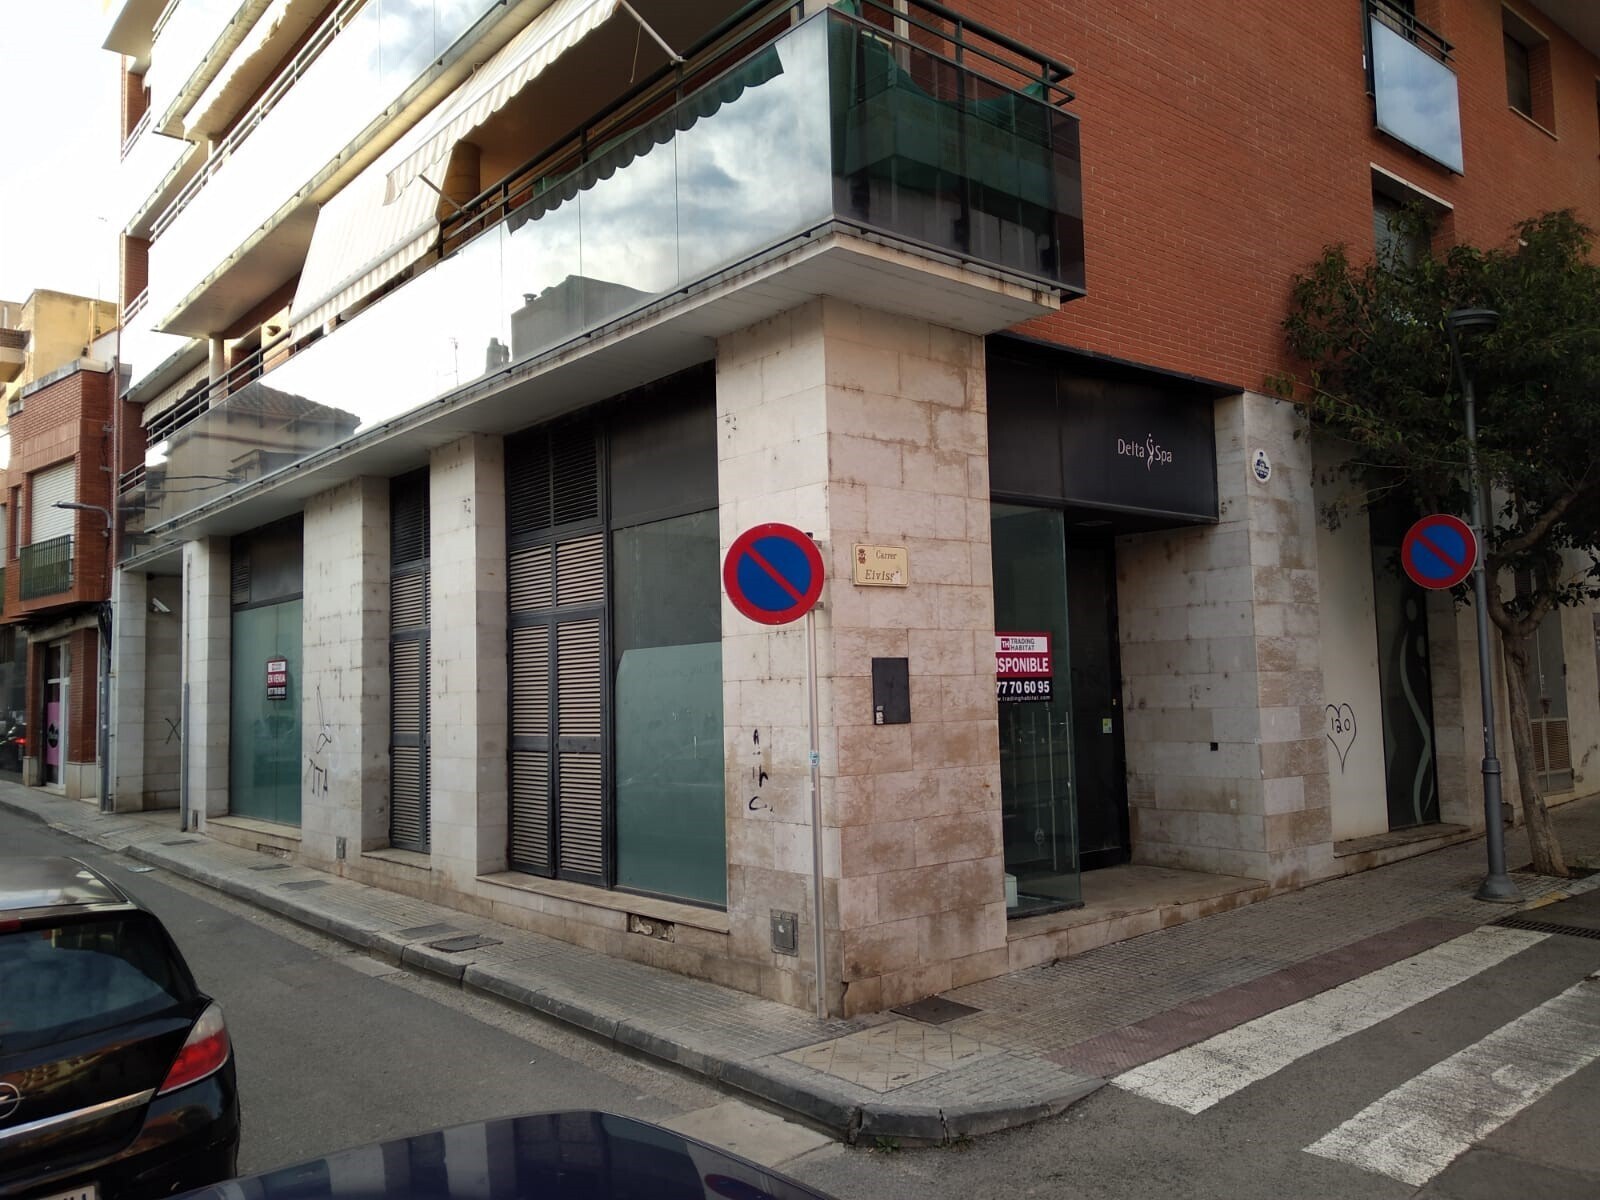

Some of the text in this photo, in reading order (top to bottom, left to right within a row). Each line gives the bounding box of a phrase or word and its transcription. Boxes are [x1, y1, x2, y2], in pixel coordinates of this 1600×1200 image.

[1117, 438, 1173, 466] Delta Spa
[875, 550, 897, 560] Carrer
[996, 657, 1049, 673] ISPONIBLE
[1009, 681, 1023, 694] 70
[1023, 681, 1037, 694] 60
[1037, 681, 1050, 694] 95
